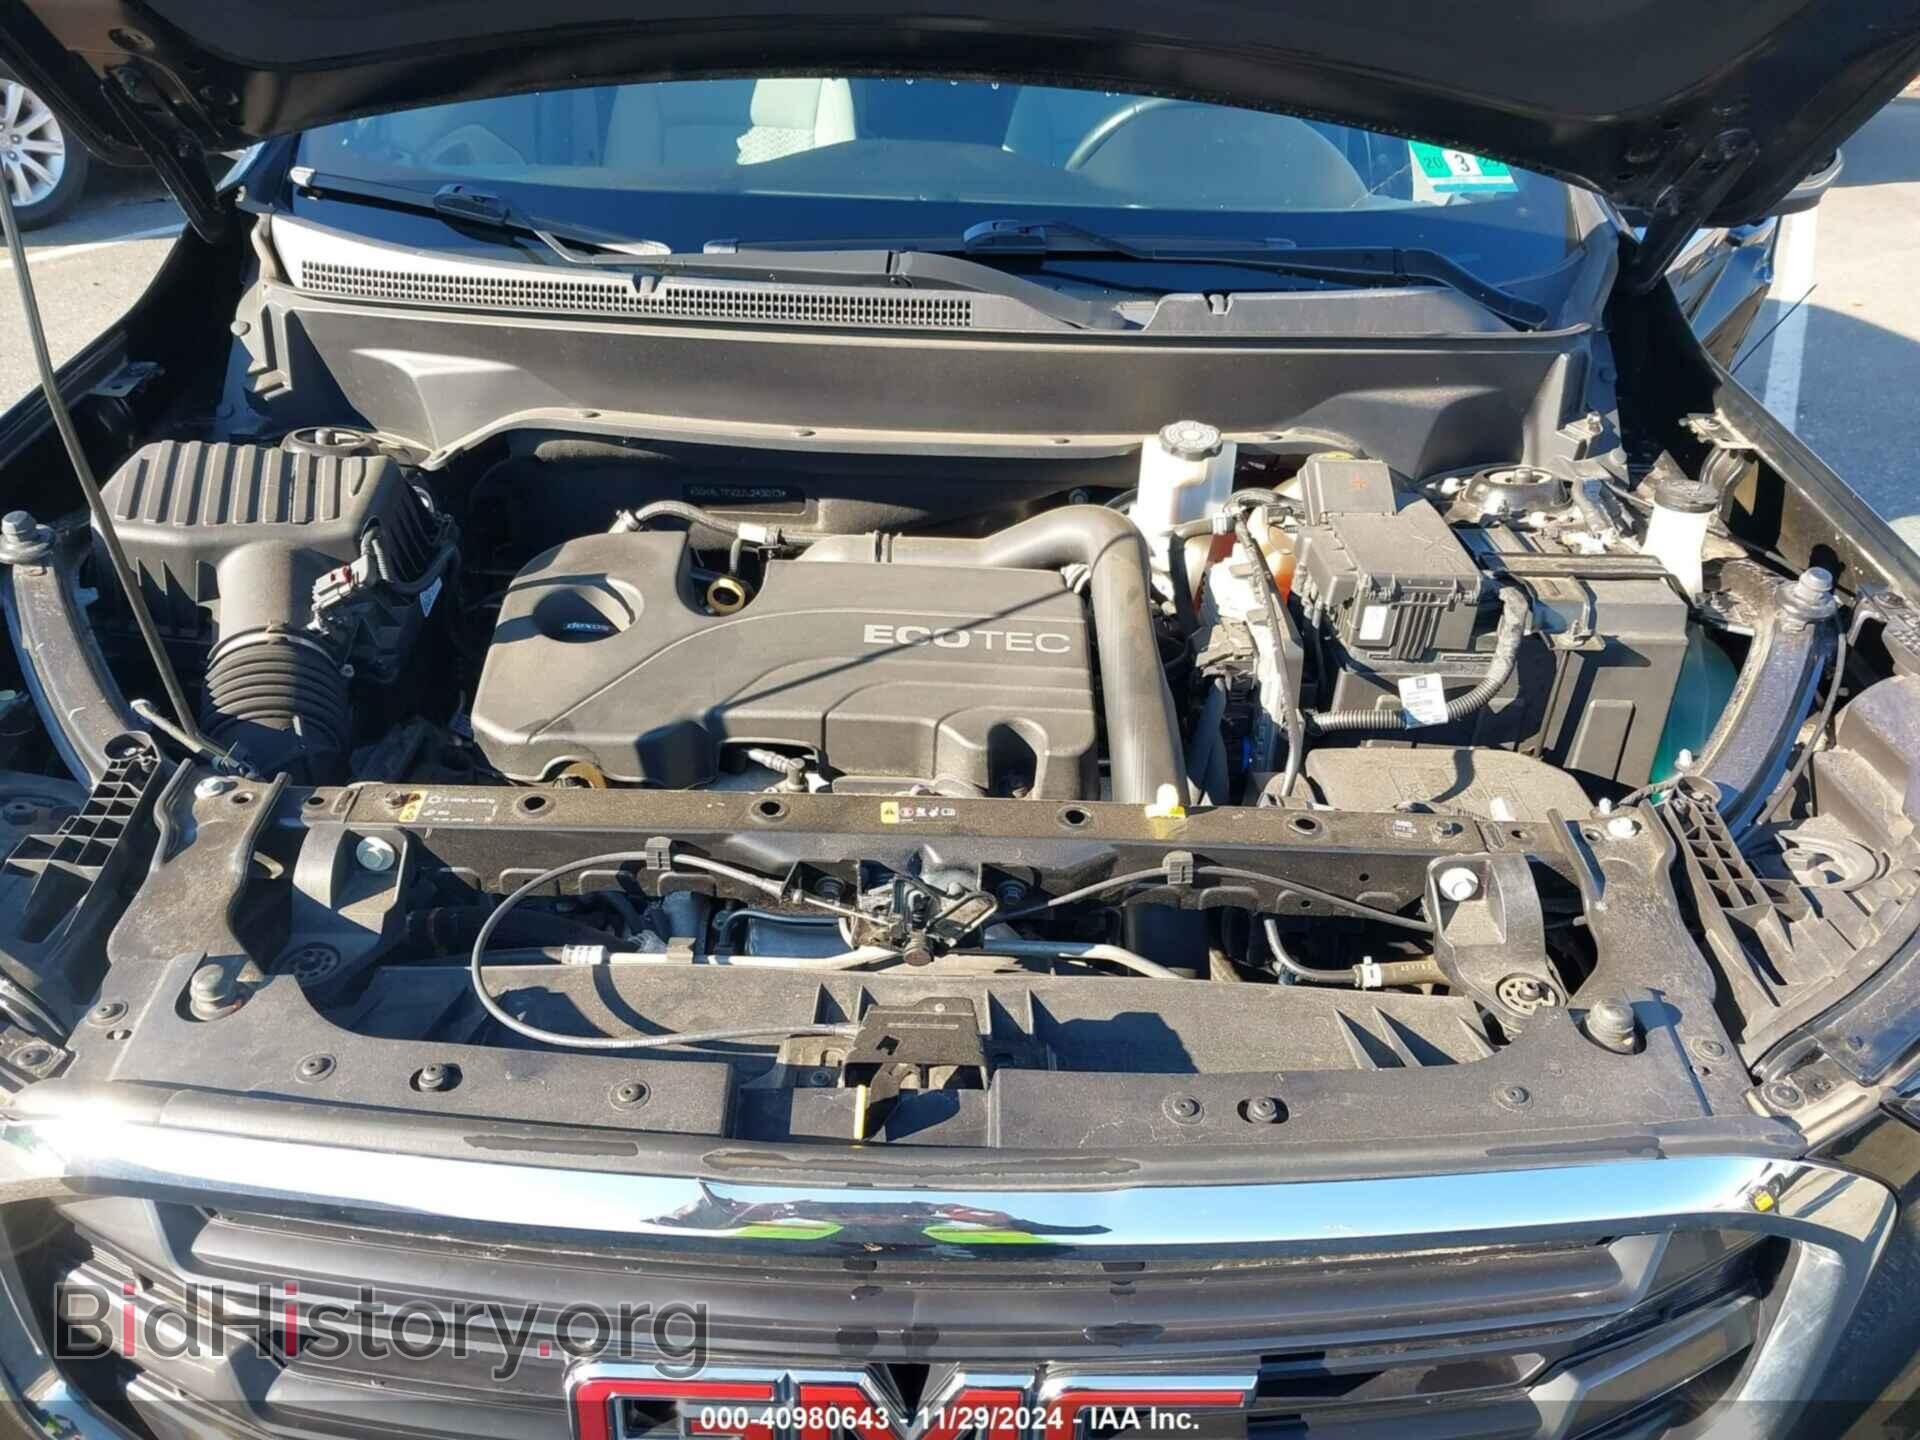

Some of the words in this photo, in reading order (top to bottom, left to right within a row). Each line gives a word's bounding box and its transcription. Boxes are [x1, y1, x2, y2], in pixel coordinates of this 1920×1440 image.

[1423, 156, 1443, 169] 20
[1454, 154, 1471, 172] 3
[863, 623, 1072, 654] ECOTEC
